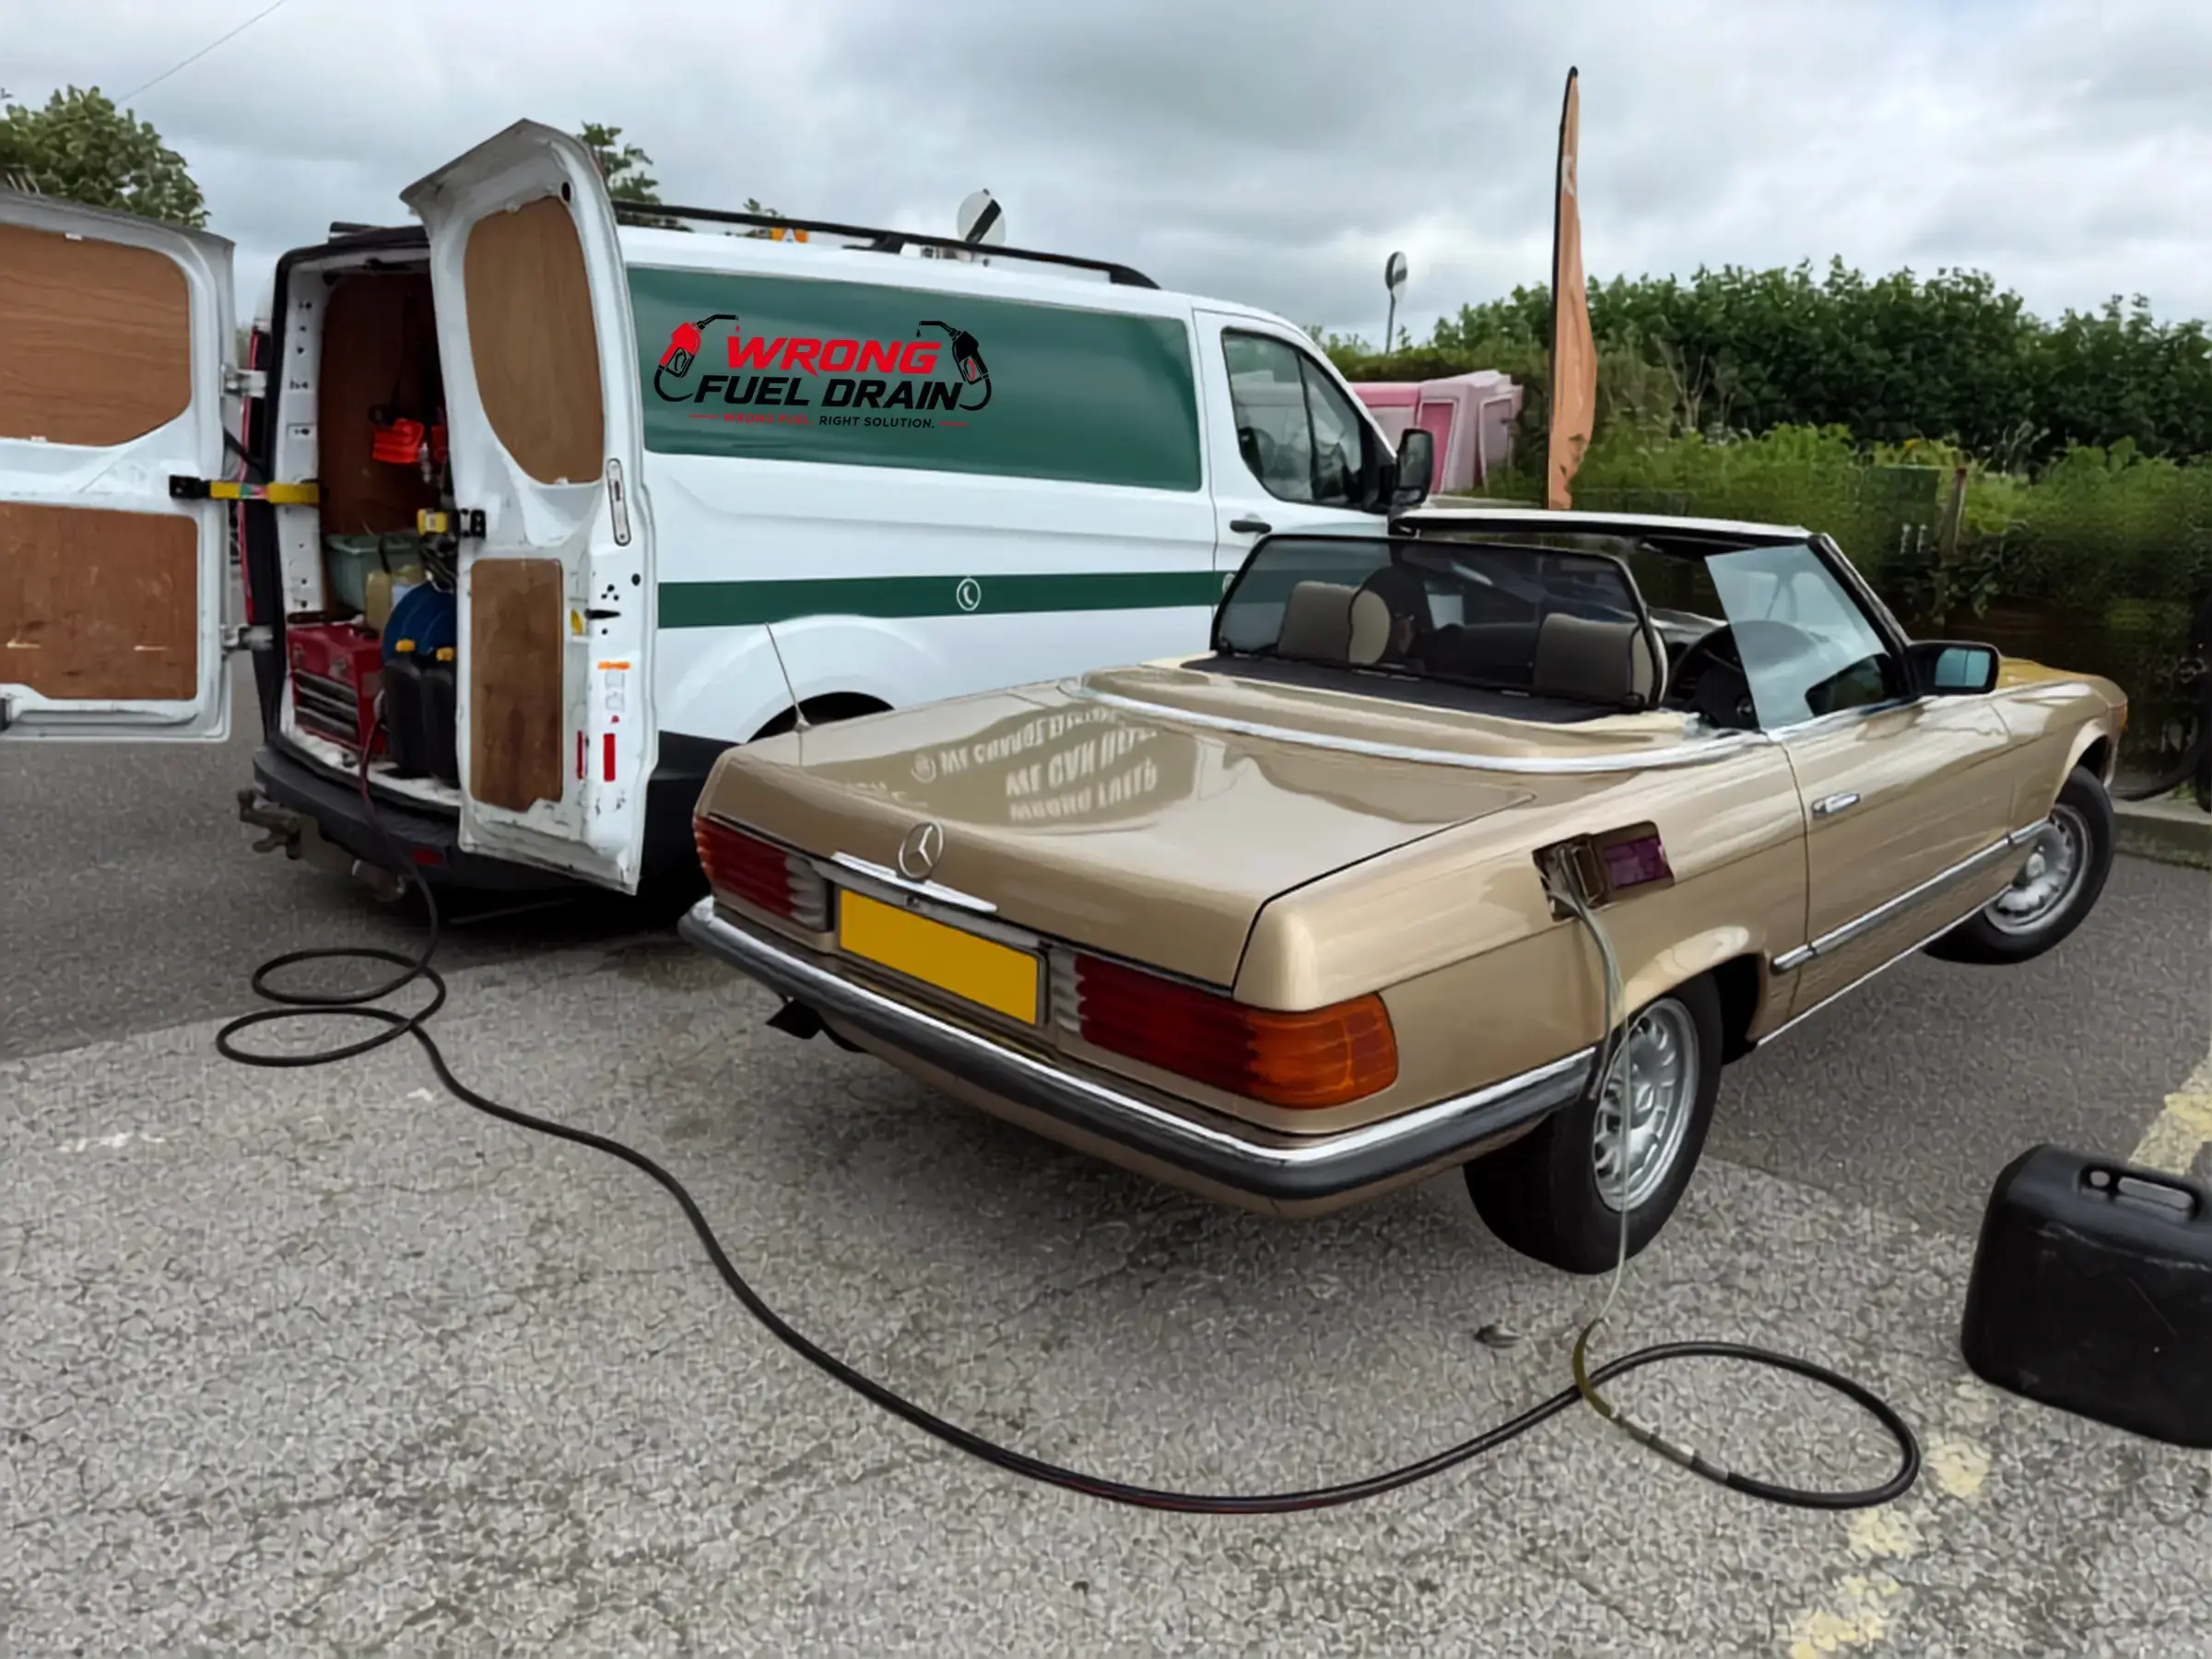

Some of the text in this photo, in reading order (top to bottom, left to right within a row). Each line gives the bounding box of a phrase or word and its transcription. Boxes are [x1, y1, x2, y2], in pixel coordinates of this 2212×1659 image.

[726, 336, 941, 378] WRONG
[694, 375, 963, 410] FUEL DRAIN
[724, 413, 773, 424] WRONG
[819, 416, 860, 426] RIGHT
[864, 418, 935, 429] SOLUTION.
